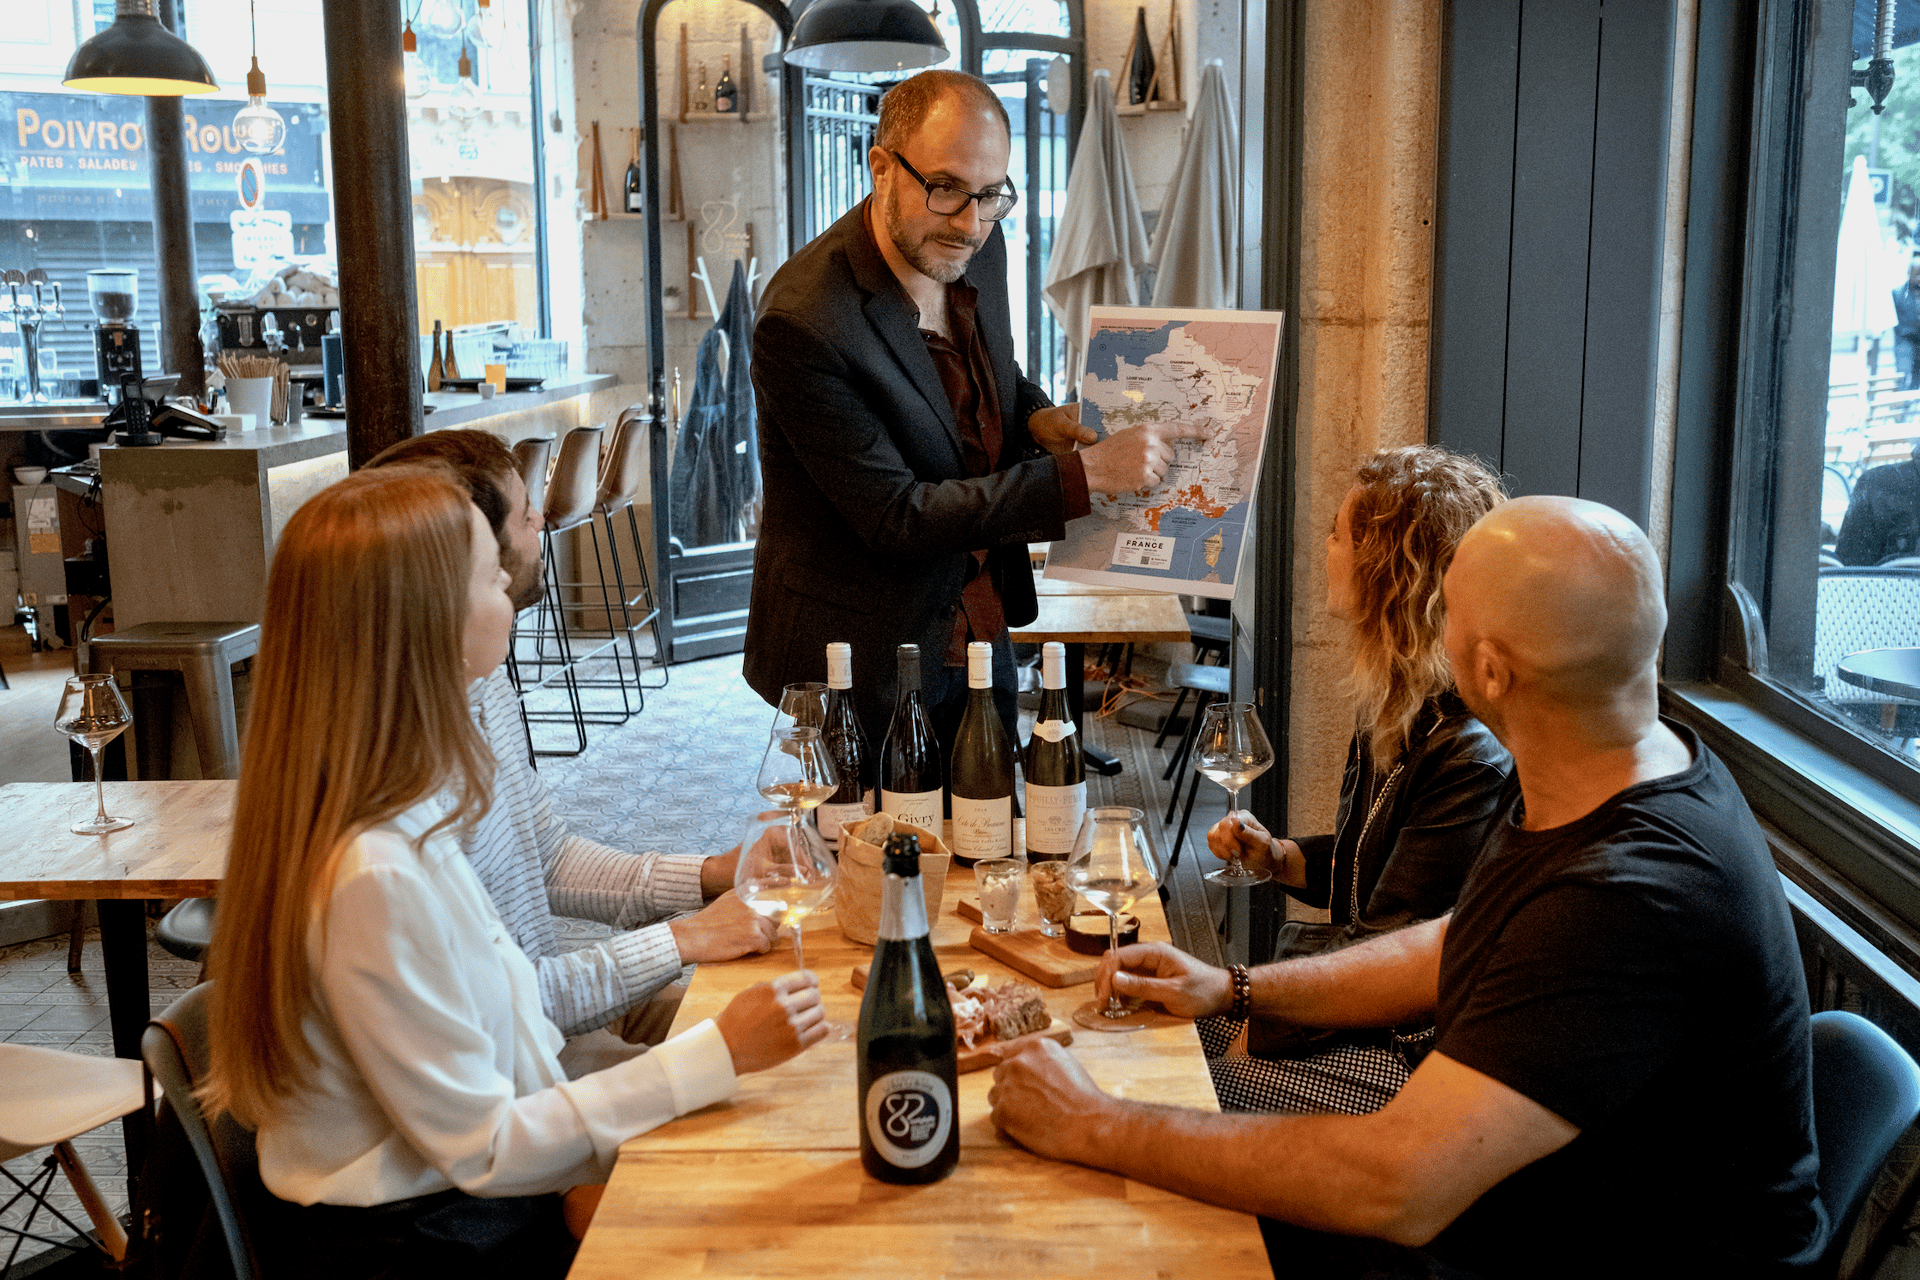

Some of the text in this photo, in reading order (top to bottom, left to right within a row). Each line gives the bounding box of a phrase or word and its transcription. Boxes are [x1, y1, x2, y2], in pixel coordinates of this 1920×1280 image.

[17, 108, 286, 154] POIVRO ROU
[20, 156, 64, 169] PATES
[215, 161, 288, 175] SMOHIES
[1126, 539, 1164, 549] FRANCE
[897, 813, 934, 827] Givry
